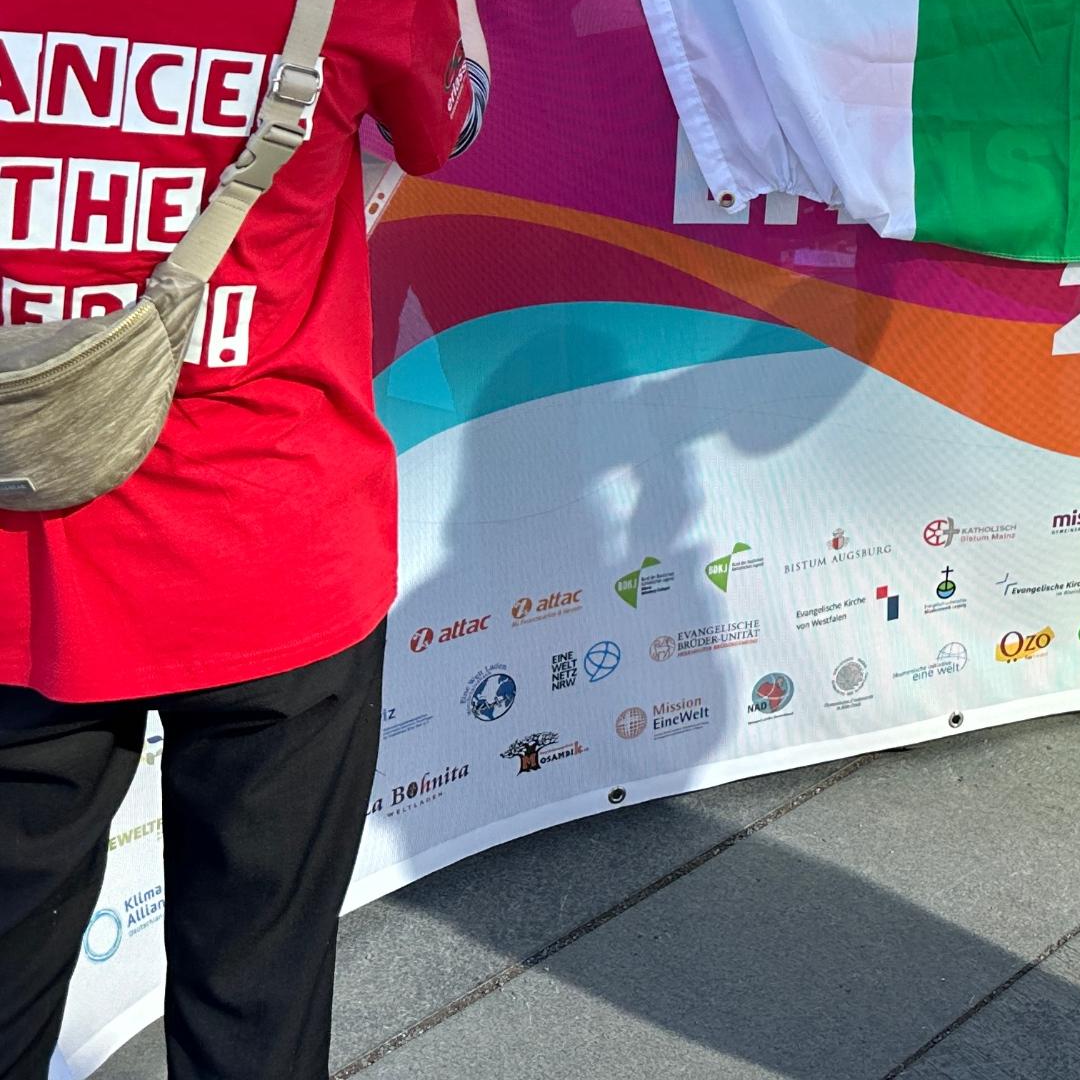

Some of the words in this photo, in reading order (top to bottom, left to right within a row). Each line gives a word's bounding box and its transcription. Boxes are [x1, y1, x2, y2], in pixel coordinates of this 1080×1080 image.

[0, 165, 194, 245] THE
[784, 557, 828, 575] BISTUM
[831, 544, 893, 565] AUGSBURG
[536, 588, 584, 613] attac
[437, 613, 493, 644] attac
[676, 619, 762, 642] EVANGELISCHE
[551, 658, 578, 673] WELT
[552, 650, 573, 664] EINE
[552, 667, 578, 683] NETZ
[912, 668, 935, 682] eine
[936, 662, 960, 676] welt
[552, 677, 576, 691] NRW
[652, 696, 702, 717] Mission
[747, 700, 769, 714] NAD
[652, 706, 711, 731] EineWelt
[391, 763, 470, 808] Bohnita
